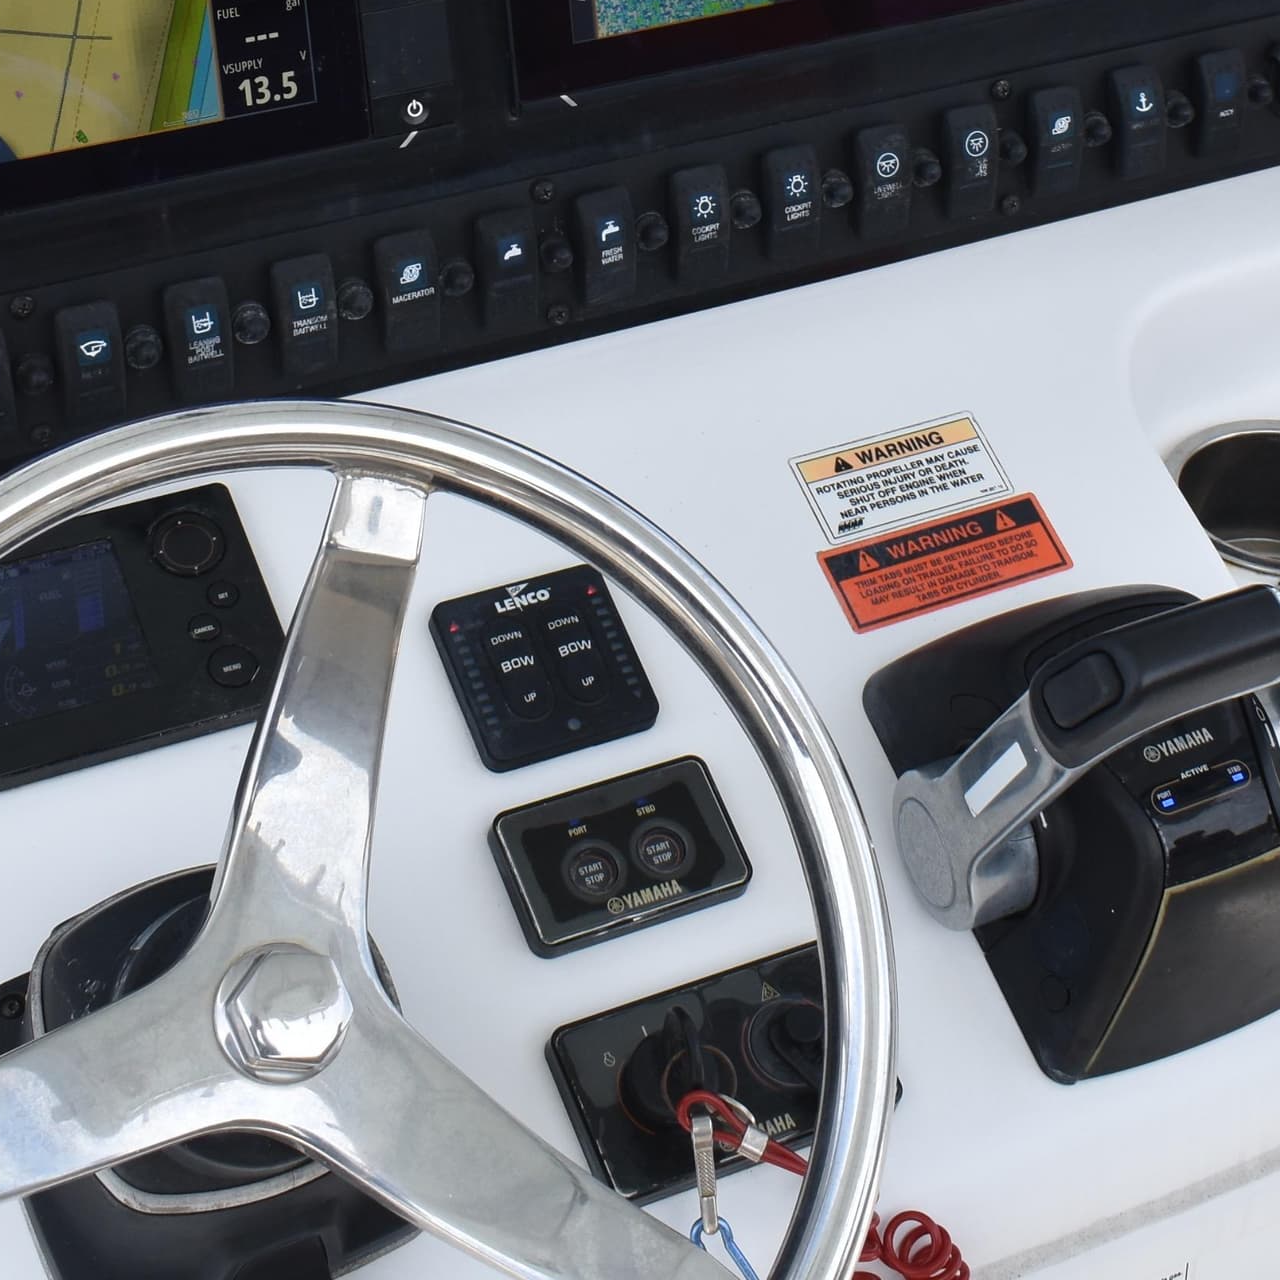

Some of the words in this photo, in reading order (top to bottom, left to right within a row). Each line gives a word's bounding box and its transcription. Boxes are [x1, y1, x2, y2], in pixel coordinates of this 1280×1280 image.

[217, 7, 240, 20] FUEL
[222, 57, 263, 75] VSUPPLY
[299, 50, 307, 61] V
[238, 70, 298, 107] 13.5
[785, 201, 812, 215] COCKPIT
[787, 210, 810, 221] LIGHTS
[692, 222, 720, 236] COCKPIT
[694, 231, 718, 242] LIGHTS
[601, 253, 623, 265] WATER
[602, 246, 623, 259] FRESH
[392, 287, 435, 304] MACERATOR
[293, 315, 328, 329] TRANSOM
[855, 431, 944, 465] WARNING
[816, 476, 865, 495] ROTATING
[867, 460, 924, 482] PROPELLER
[925, 453, 945, 465] MAY
[947, 444, 980, 459] CAUSE
[837, 482, 881, 500] SERIOUS
[882, 471, 916, 486] INJURY
[920, 468, 933, 477] OR
[935, 458, 969, 472] DEATH.
[849, 494, 876, 506] SHUT
[879, 488, 897, 499] OFF
[899, 476, 935, 492] ENGINE
[937, 468, 966, 481] WHEN
[840, 506, 869, 519] NEAR
[870, 493, 917, 511] PERSONS
[919, 489, 929, 497] IN
[929, 482, 950, 494] THE
[950, 473, 985, 489] WATER
[887, 521, 983, 560] WARNING
[855, 577, 878, 589] TRIM
[879, 571, 902, 582] TABS
[904, 563, 929, 575] MUST
[931, 558, 942, 568] BE
[944, 542, 996, 563] RETRACTED
[997, 531, 1032, 546] BEFORE
[860, 583, 901, 599] LOADING
[902, 577, 916, 587] ON
[958, 552, 996, 568] FAILURE
[997, 548, 1008, 558] TO
[1010, 543, 1024, 553] DO
[1025, 539, 1037, 549] SO
[871, 594, 891, 606] MAY
[892, 583, 927, 599] RESULT
[928, 580, 937, 588] IN
[939, 569, 977, 585] DAMAGE
[979, 563, 990, 573] TO
[495, 589, 550, 613] LENCO
[915, 590, 941, 602] TABS
[942, 585, 954, 597] OR
[194, 624, 216, 634] CANCEL
[547, 615, 579, 631] DOWN
[490, 630, 522, 646] DOWN
[558, 639, 592, 658] BOW
[222, 662, 242, 673] MENU
[500, 655, 535, 673] BOW
[581, 675, 594, 687] UP
[524, 692, 537, 703] UP
[1157, 727, 1214, 757] YAMAHA
[1181, 764, 1209, 780] ACTIVE
[1157, 789, 1172, 800] PORT
[636, 805, 656, 817] STBD
[568, 824, 587, 837] PORT
[646, 841, 671, 855] START
[652, 851, 672, 865] STOP
[578, 861, 603, 876] START
[585, 873, 605, 885] STOP
[623, 879, 682, 909] YAMAHA
